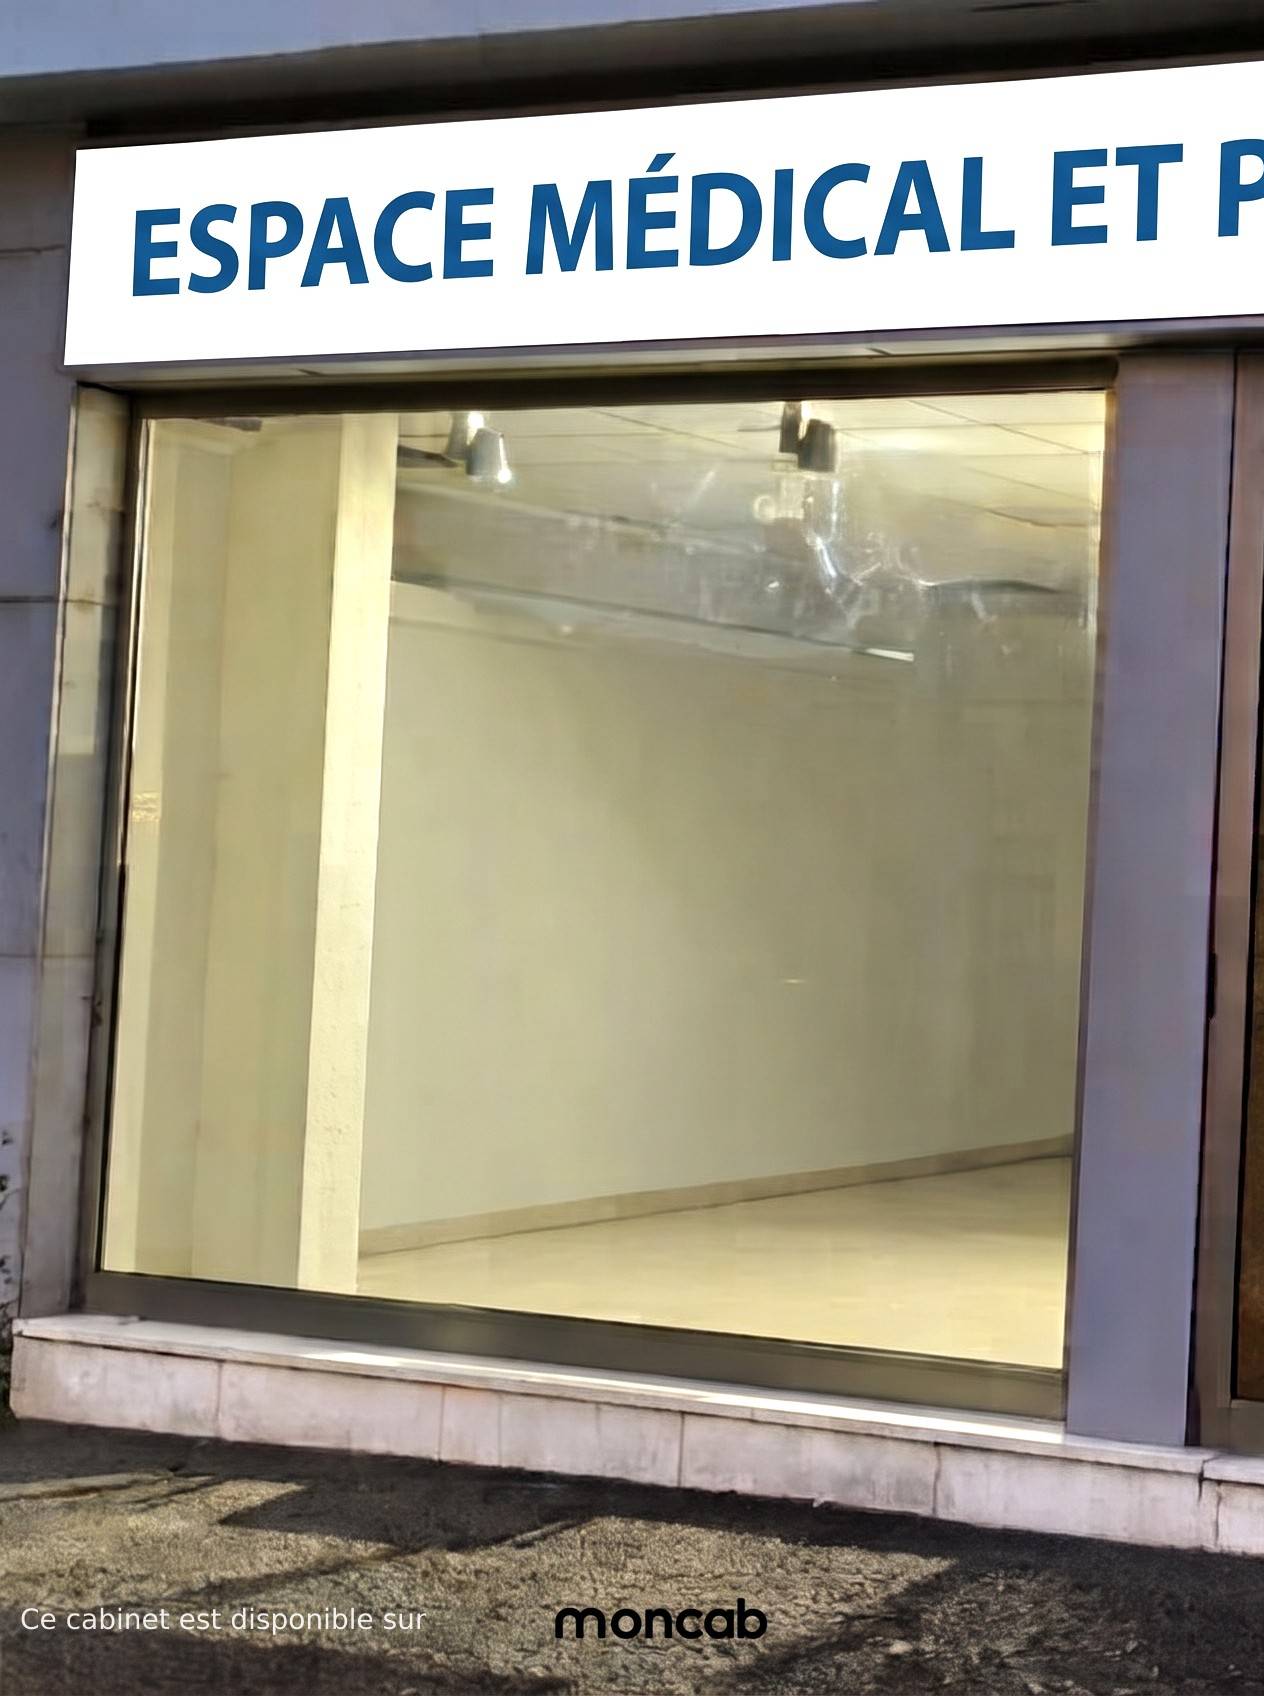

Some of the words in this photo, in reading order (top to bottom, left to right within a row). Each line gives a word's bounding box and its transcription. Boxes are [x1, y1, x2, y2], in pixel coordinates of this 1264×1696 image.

[133, 188, 493, 296] ESPACE
[526, 153, 1014, 275] MÉDICAL
[1052, 143, 1183, 245] ET
